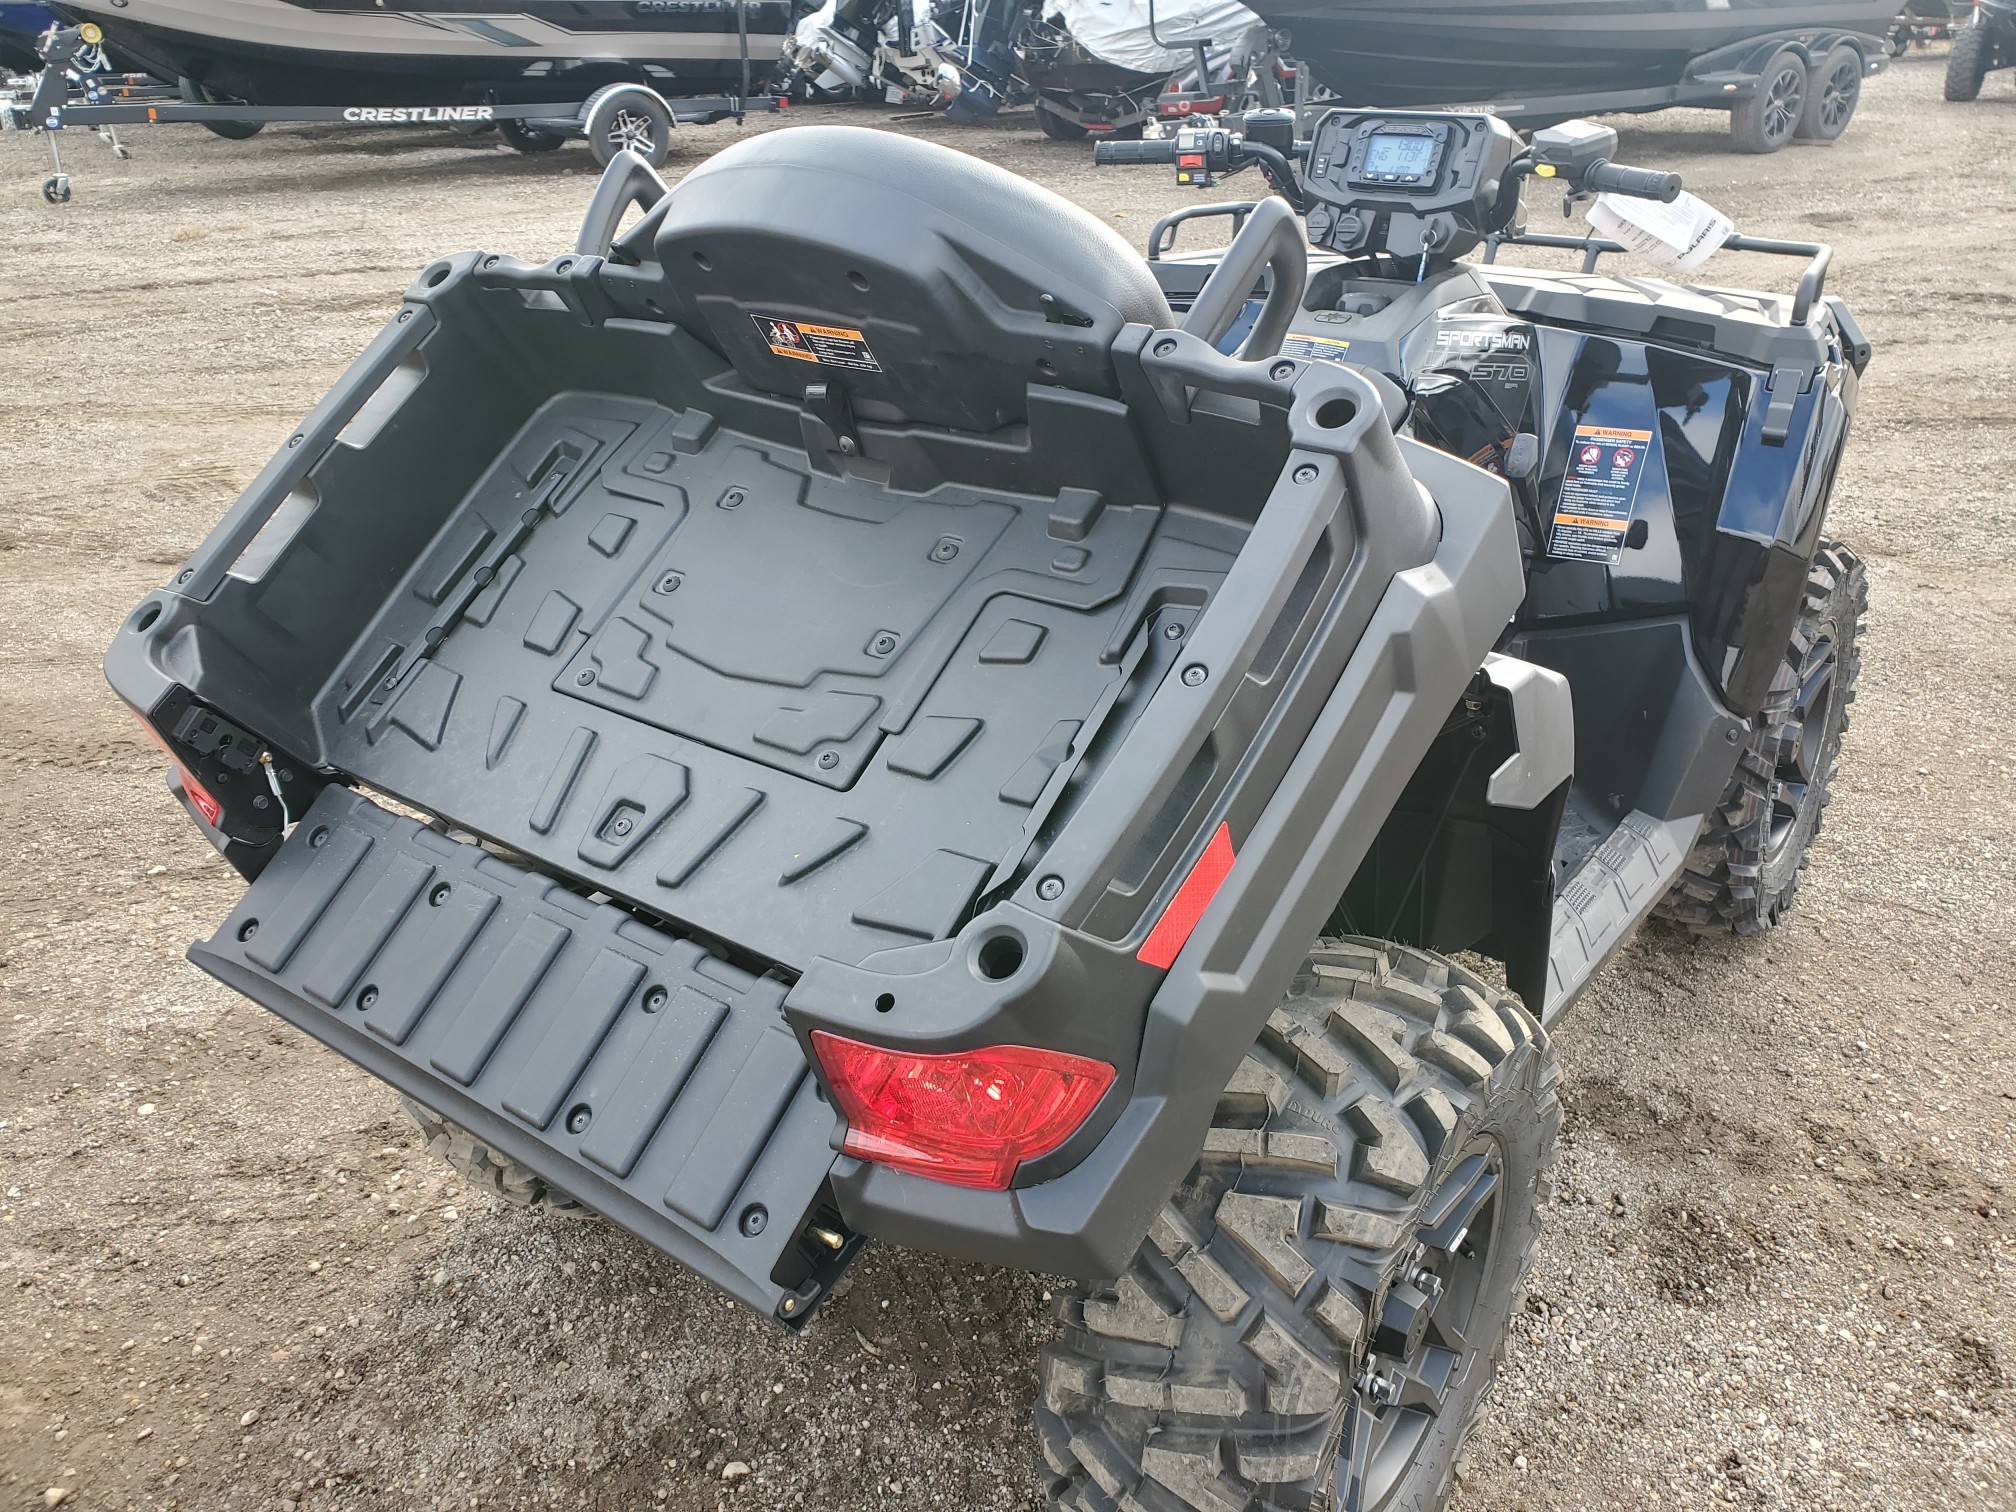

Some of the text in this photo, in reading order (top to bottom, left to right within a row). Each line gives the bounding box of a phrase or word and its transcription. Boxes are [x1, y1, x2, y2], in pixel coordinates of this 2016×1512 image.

[343, 106, 493, 121] CRESTLINER
[1677, 217, 1717, 260] POLARIS
[816, 328, 849, 338] WARNING
[1436, 330, 1531, 350] SPORTSMAN
[782, 348, 813, 360] WARNING
[1469, 362, 1530, 381] 570
[1602, 429, 1633, 438] WARNING
[1580, 517, 1610, 527] WARNING
